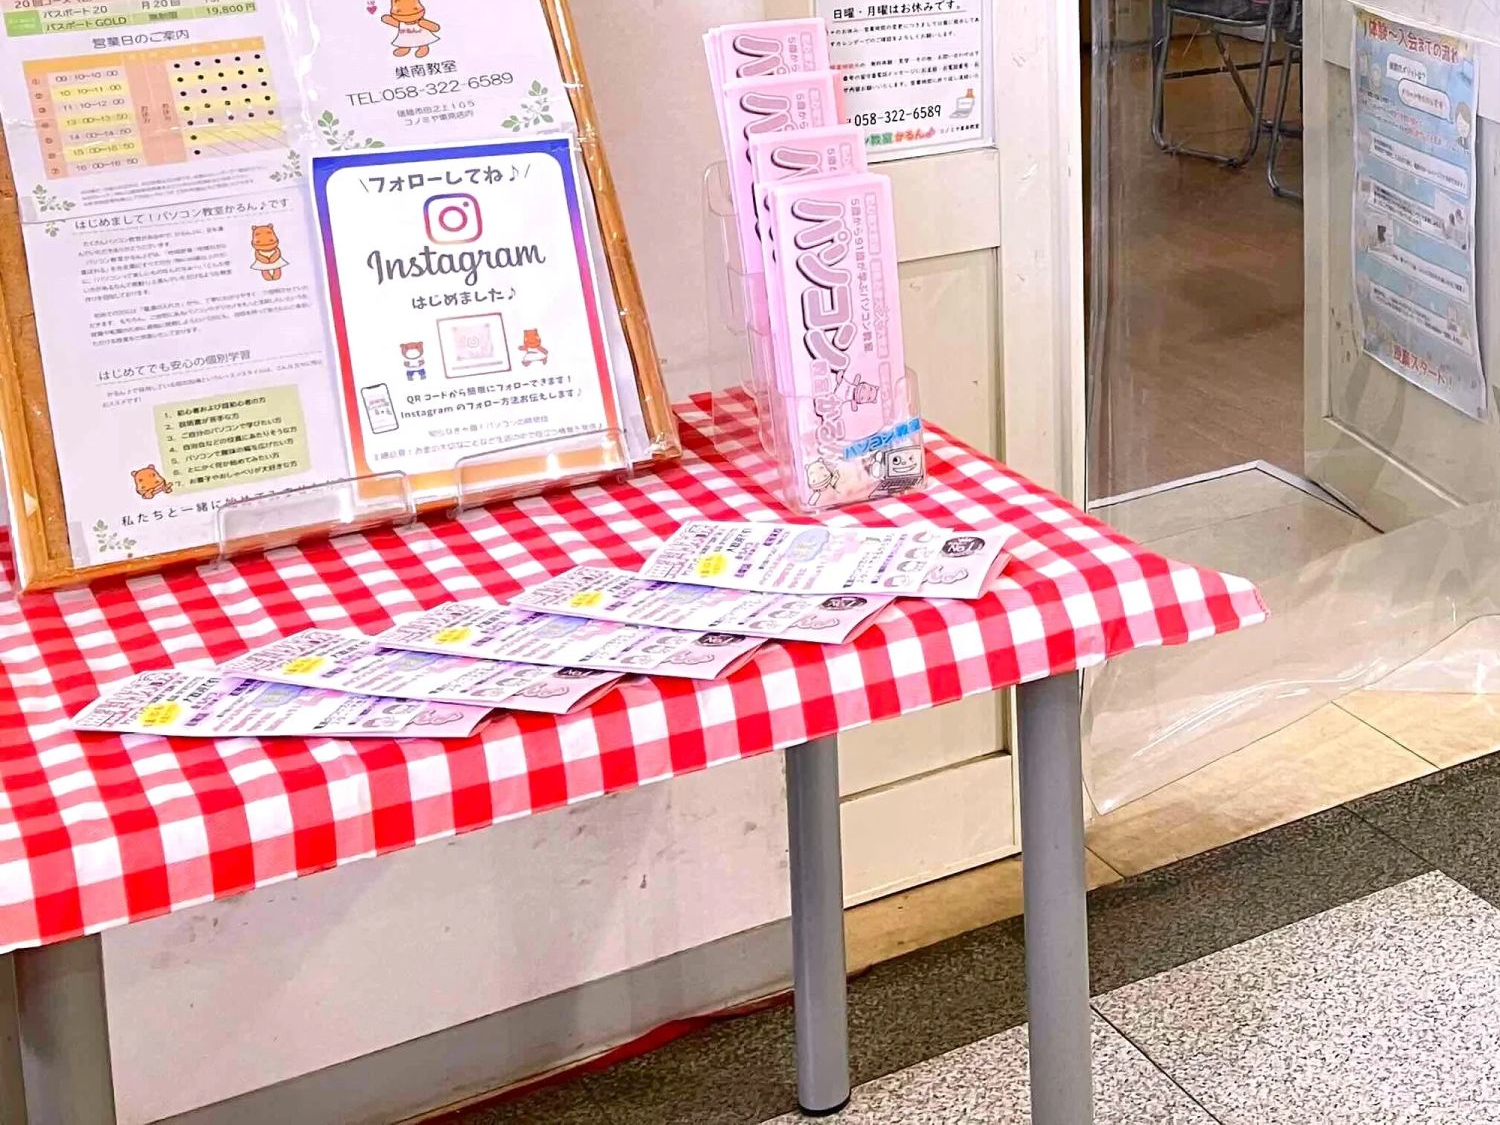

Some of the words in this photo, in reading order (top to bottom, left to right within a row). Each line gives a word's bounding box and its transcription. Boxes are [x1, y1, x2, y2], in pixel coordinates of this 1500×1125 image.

[92, 30, 190, 50] 営業日のご案内
[854, 104, 941, 127] 058-322-6589
[367, 244, 546, 287] Instagram
[99, 349, 251, 381] はじめてでも安心の個別学習
